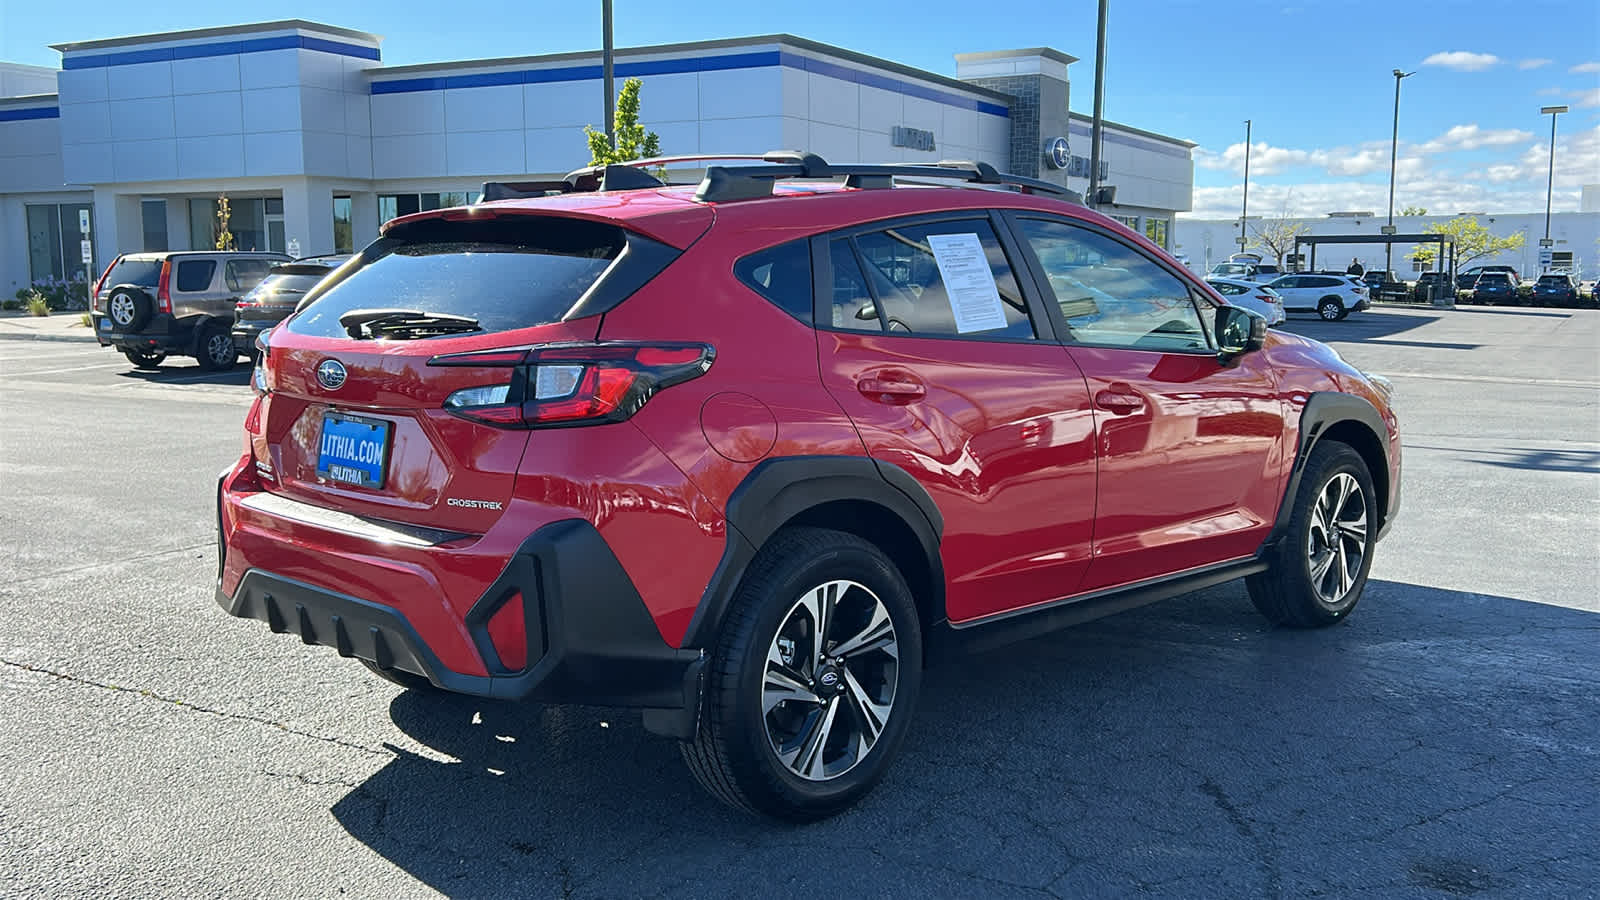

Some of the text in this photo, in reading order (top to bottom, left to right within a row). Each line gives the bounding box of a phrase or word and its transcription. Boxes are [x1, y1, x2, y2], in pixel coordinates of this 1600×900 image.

[321, 433, 384, 466] LITHIA.COM
[338, 466, 362, 485] LITHIA
[447, 498, 503, 510] CROSSTREK
